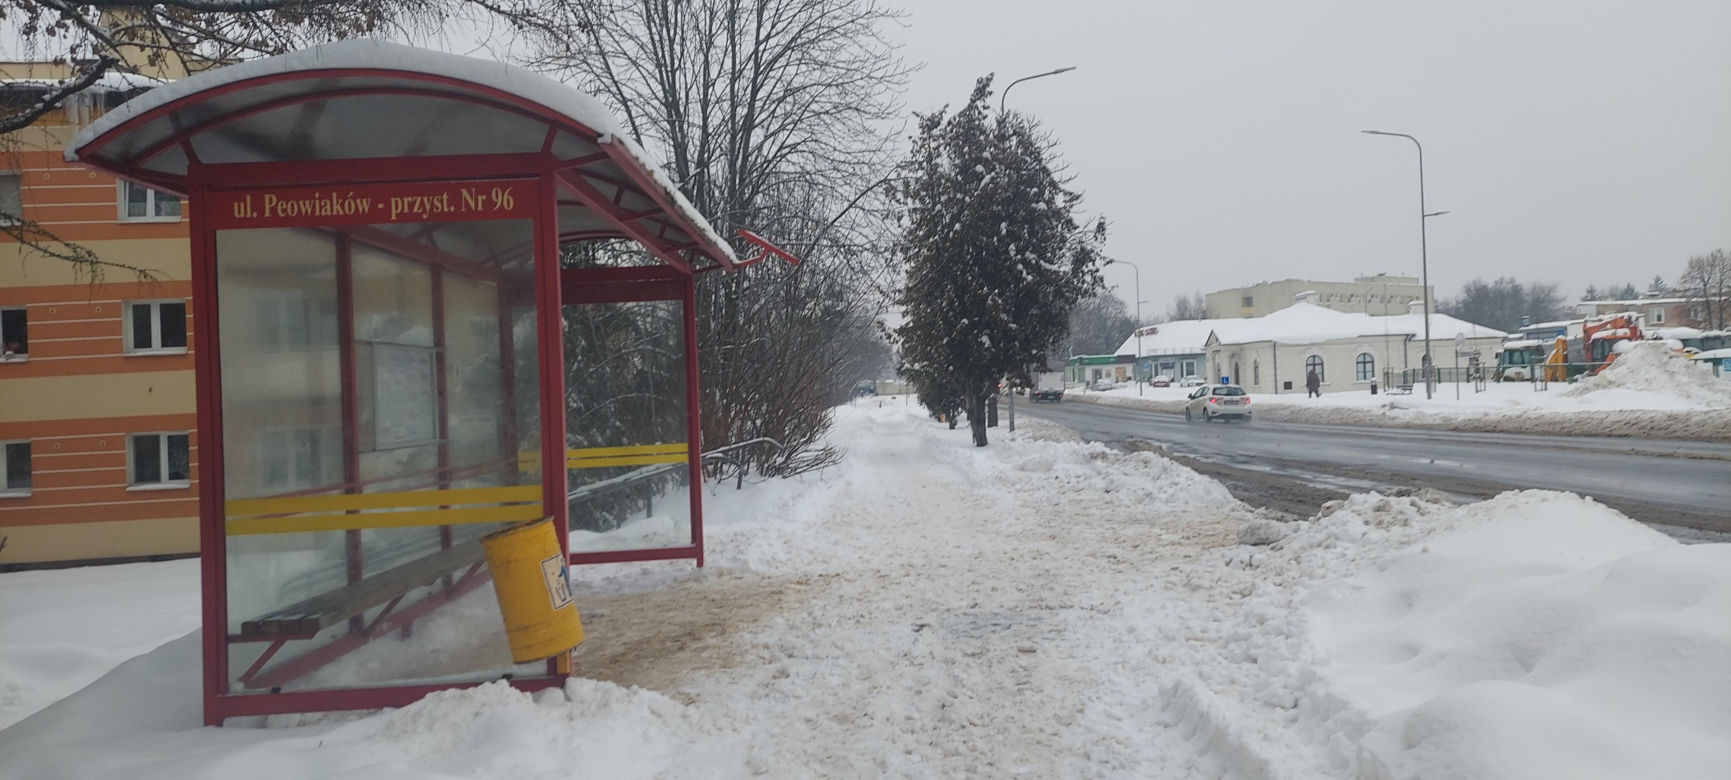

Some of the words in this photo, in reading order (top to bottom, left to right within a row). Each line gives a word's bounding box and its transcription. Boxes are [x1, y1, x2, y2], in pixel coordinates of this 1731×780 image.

[233, 194, 258, 218] ul.
[263, 191, 372, 218] Peowiaków
[391, 190, 455, 220] przyst.
[460, 187, 487, 212] Nr
[491, 186, 515, 211] 96
